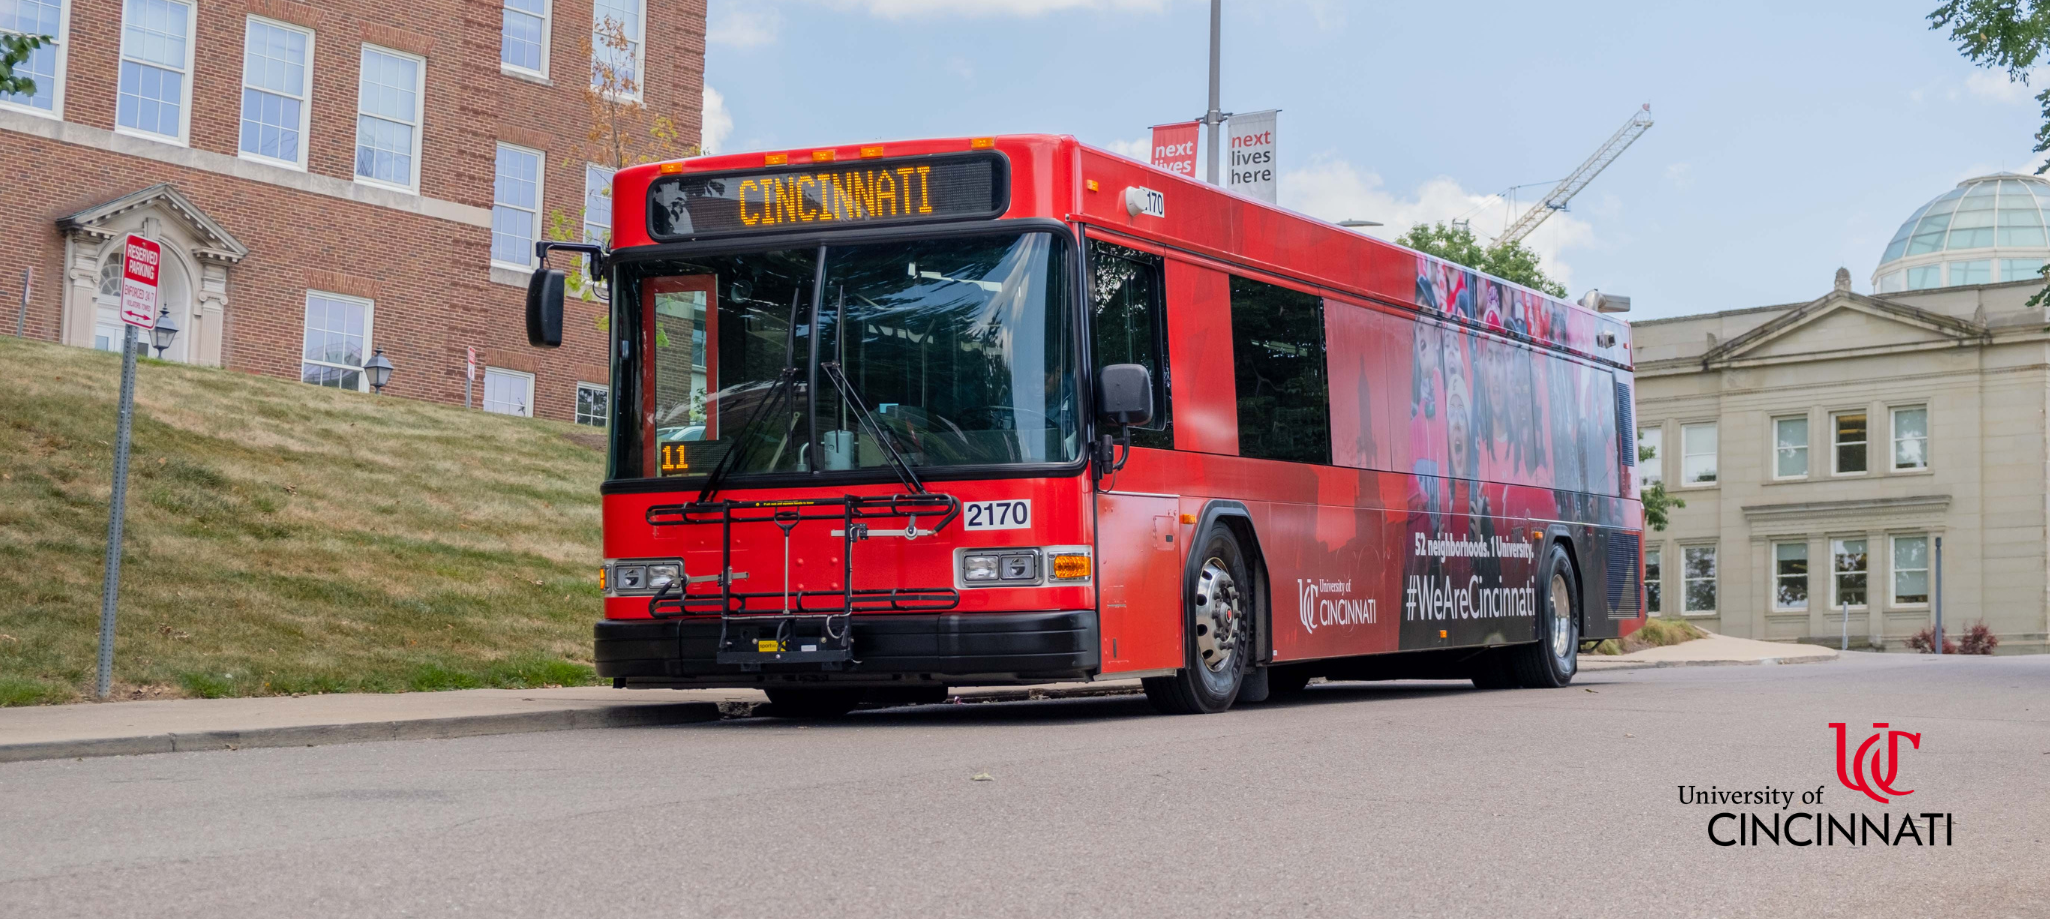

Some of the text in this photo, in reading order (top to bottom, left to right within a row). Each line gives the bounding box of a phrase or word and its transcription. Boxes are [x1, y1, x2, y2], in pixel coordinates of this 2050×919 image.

[1155, 140, 1194, 159] next
[1231, 130, 1271, 148] next
[1231, 150, 1271, 167] lives
[1231, 168, 1271, 185] here
[739, 166, 932, 226] CINCINNATI
[1145, 190, 1164, 215] 170
[127, 243, 158, 265] RESERVED
[128, 259, 155, 280] PARKING
[124, 284, 144, 300] ENFORCED
[662, 445, 688, 470] 11
[967, 501, 1028, 527] 2170
[1415, 532, 1534, 564] 52 neighborhoods. 1 University.
[1319, 579, 1352, 596] University of
[1406, 574, 1535, 621] #WeAreCincinnati
[1320, 599, 1376, 626] CINCINNATI
